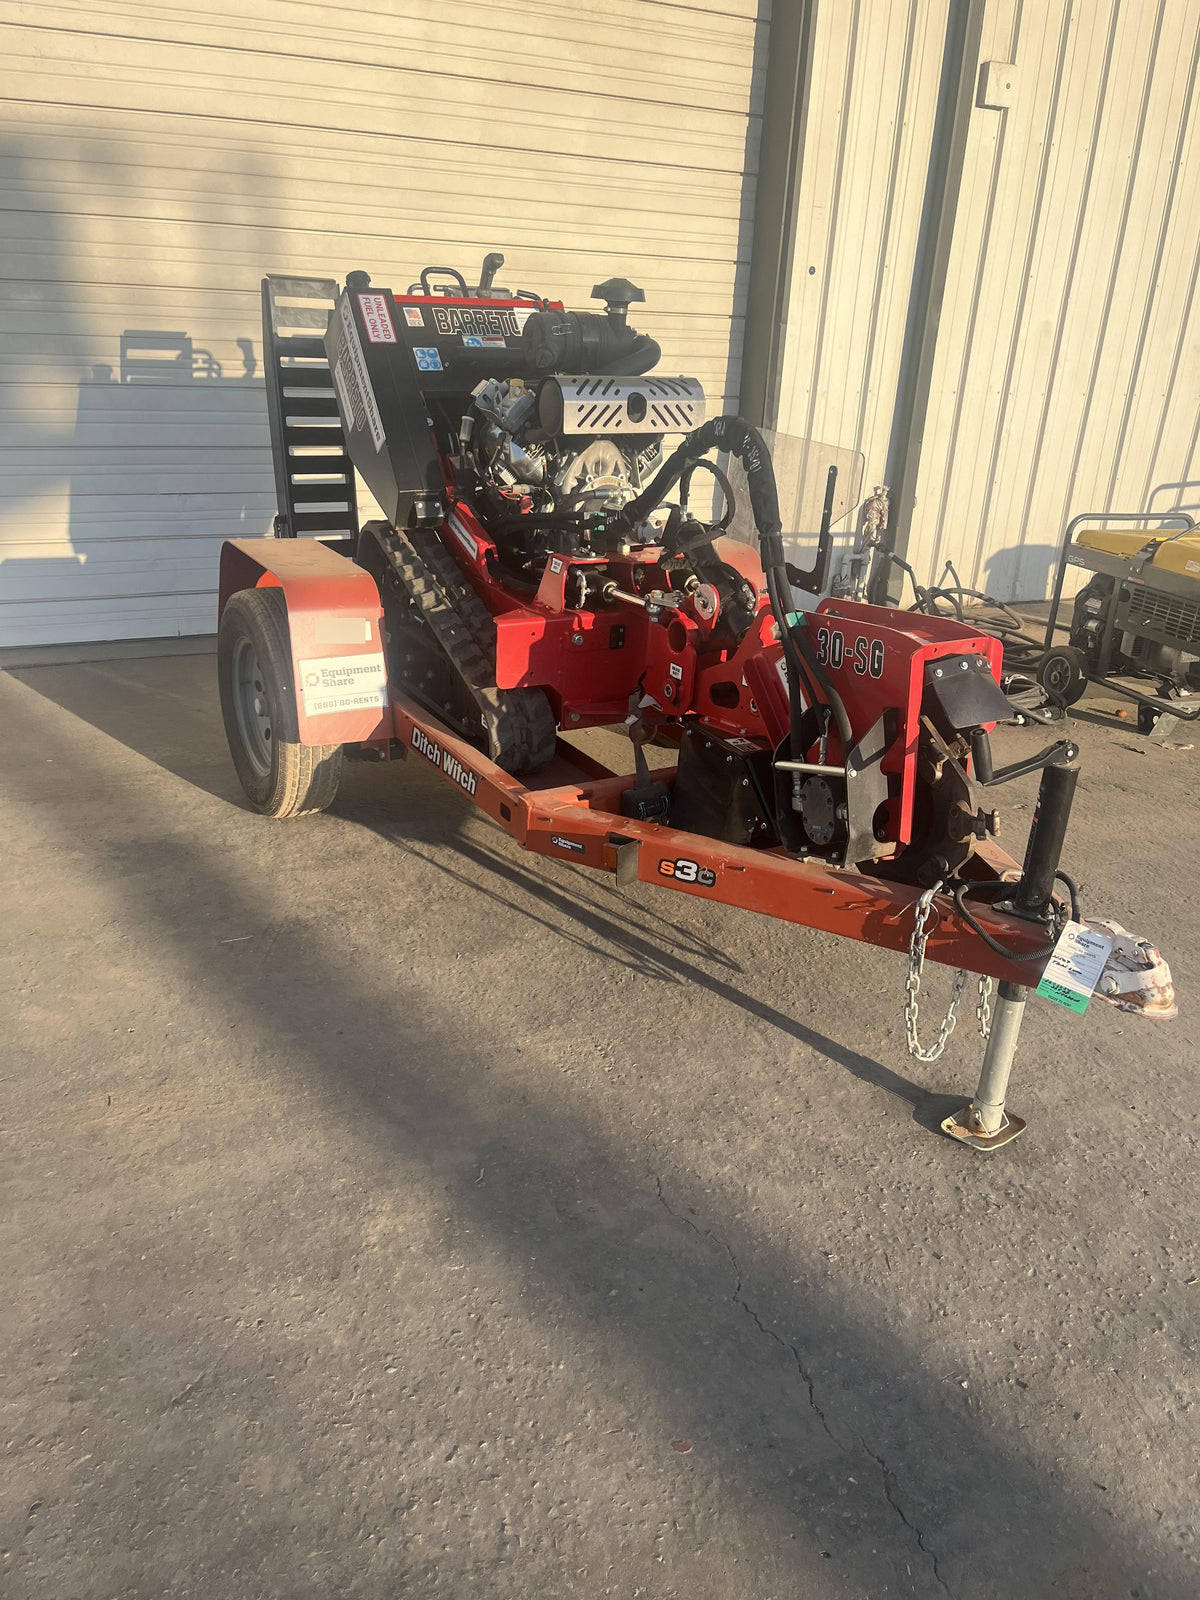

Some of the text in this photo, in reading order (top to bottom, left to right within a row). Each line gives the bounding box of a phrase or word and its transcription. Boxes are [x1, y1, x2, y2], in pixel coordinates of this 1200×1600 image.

[363, 297, 382, 339] FUEL ONLY
[373, 297, 392, 340] UNLEADED
[321, 664, 382, 678] Equipment
[817, 627, 885, 680] 30-SG
[322, 677, 355, 688] Share
[339, 695, 380, 706] 80-RENTS
[411, 726, 477, 796] Ditch Witch
